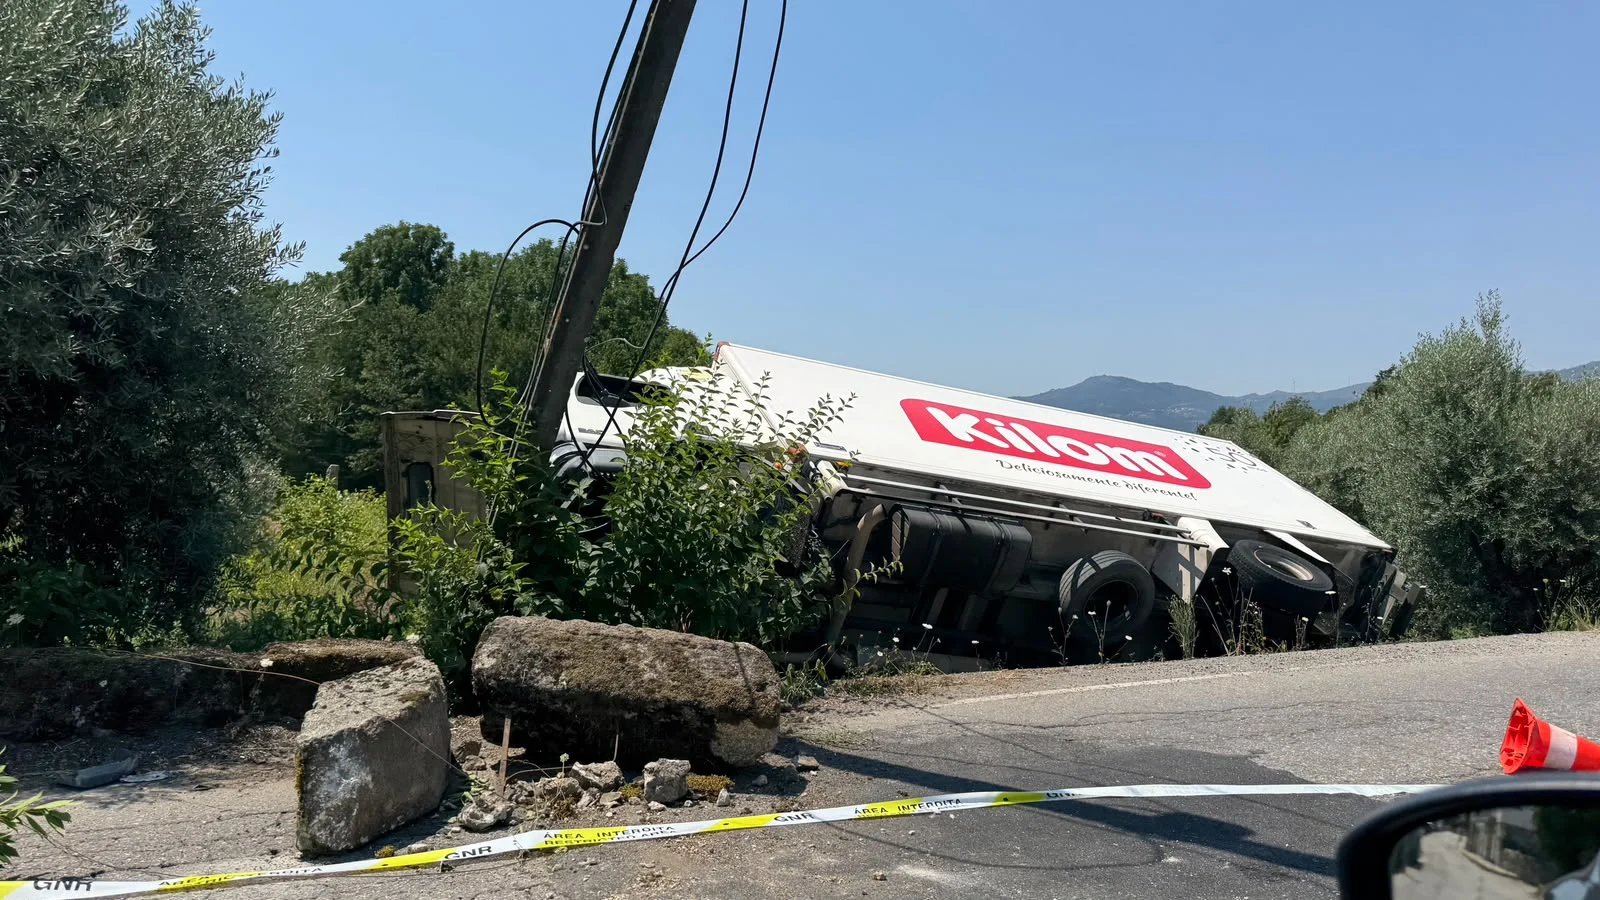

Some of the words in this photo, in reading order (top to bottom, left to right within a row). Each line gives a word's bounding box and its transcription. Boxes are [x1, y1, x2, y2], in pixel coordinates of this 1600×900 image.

[926, 406, 1188, 480] Kilom
[995, 459, 1122, 487] Deliciosamente
[1122, 480, 1198, 501] diferente!
[774, 812, 814, 823] GNR
[445, 845, 492, 859] GNR
